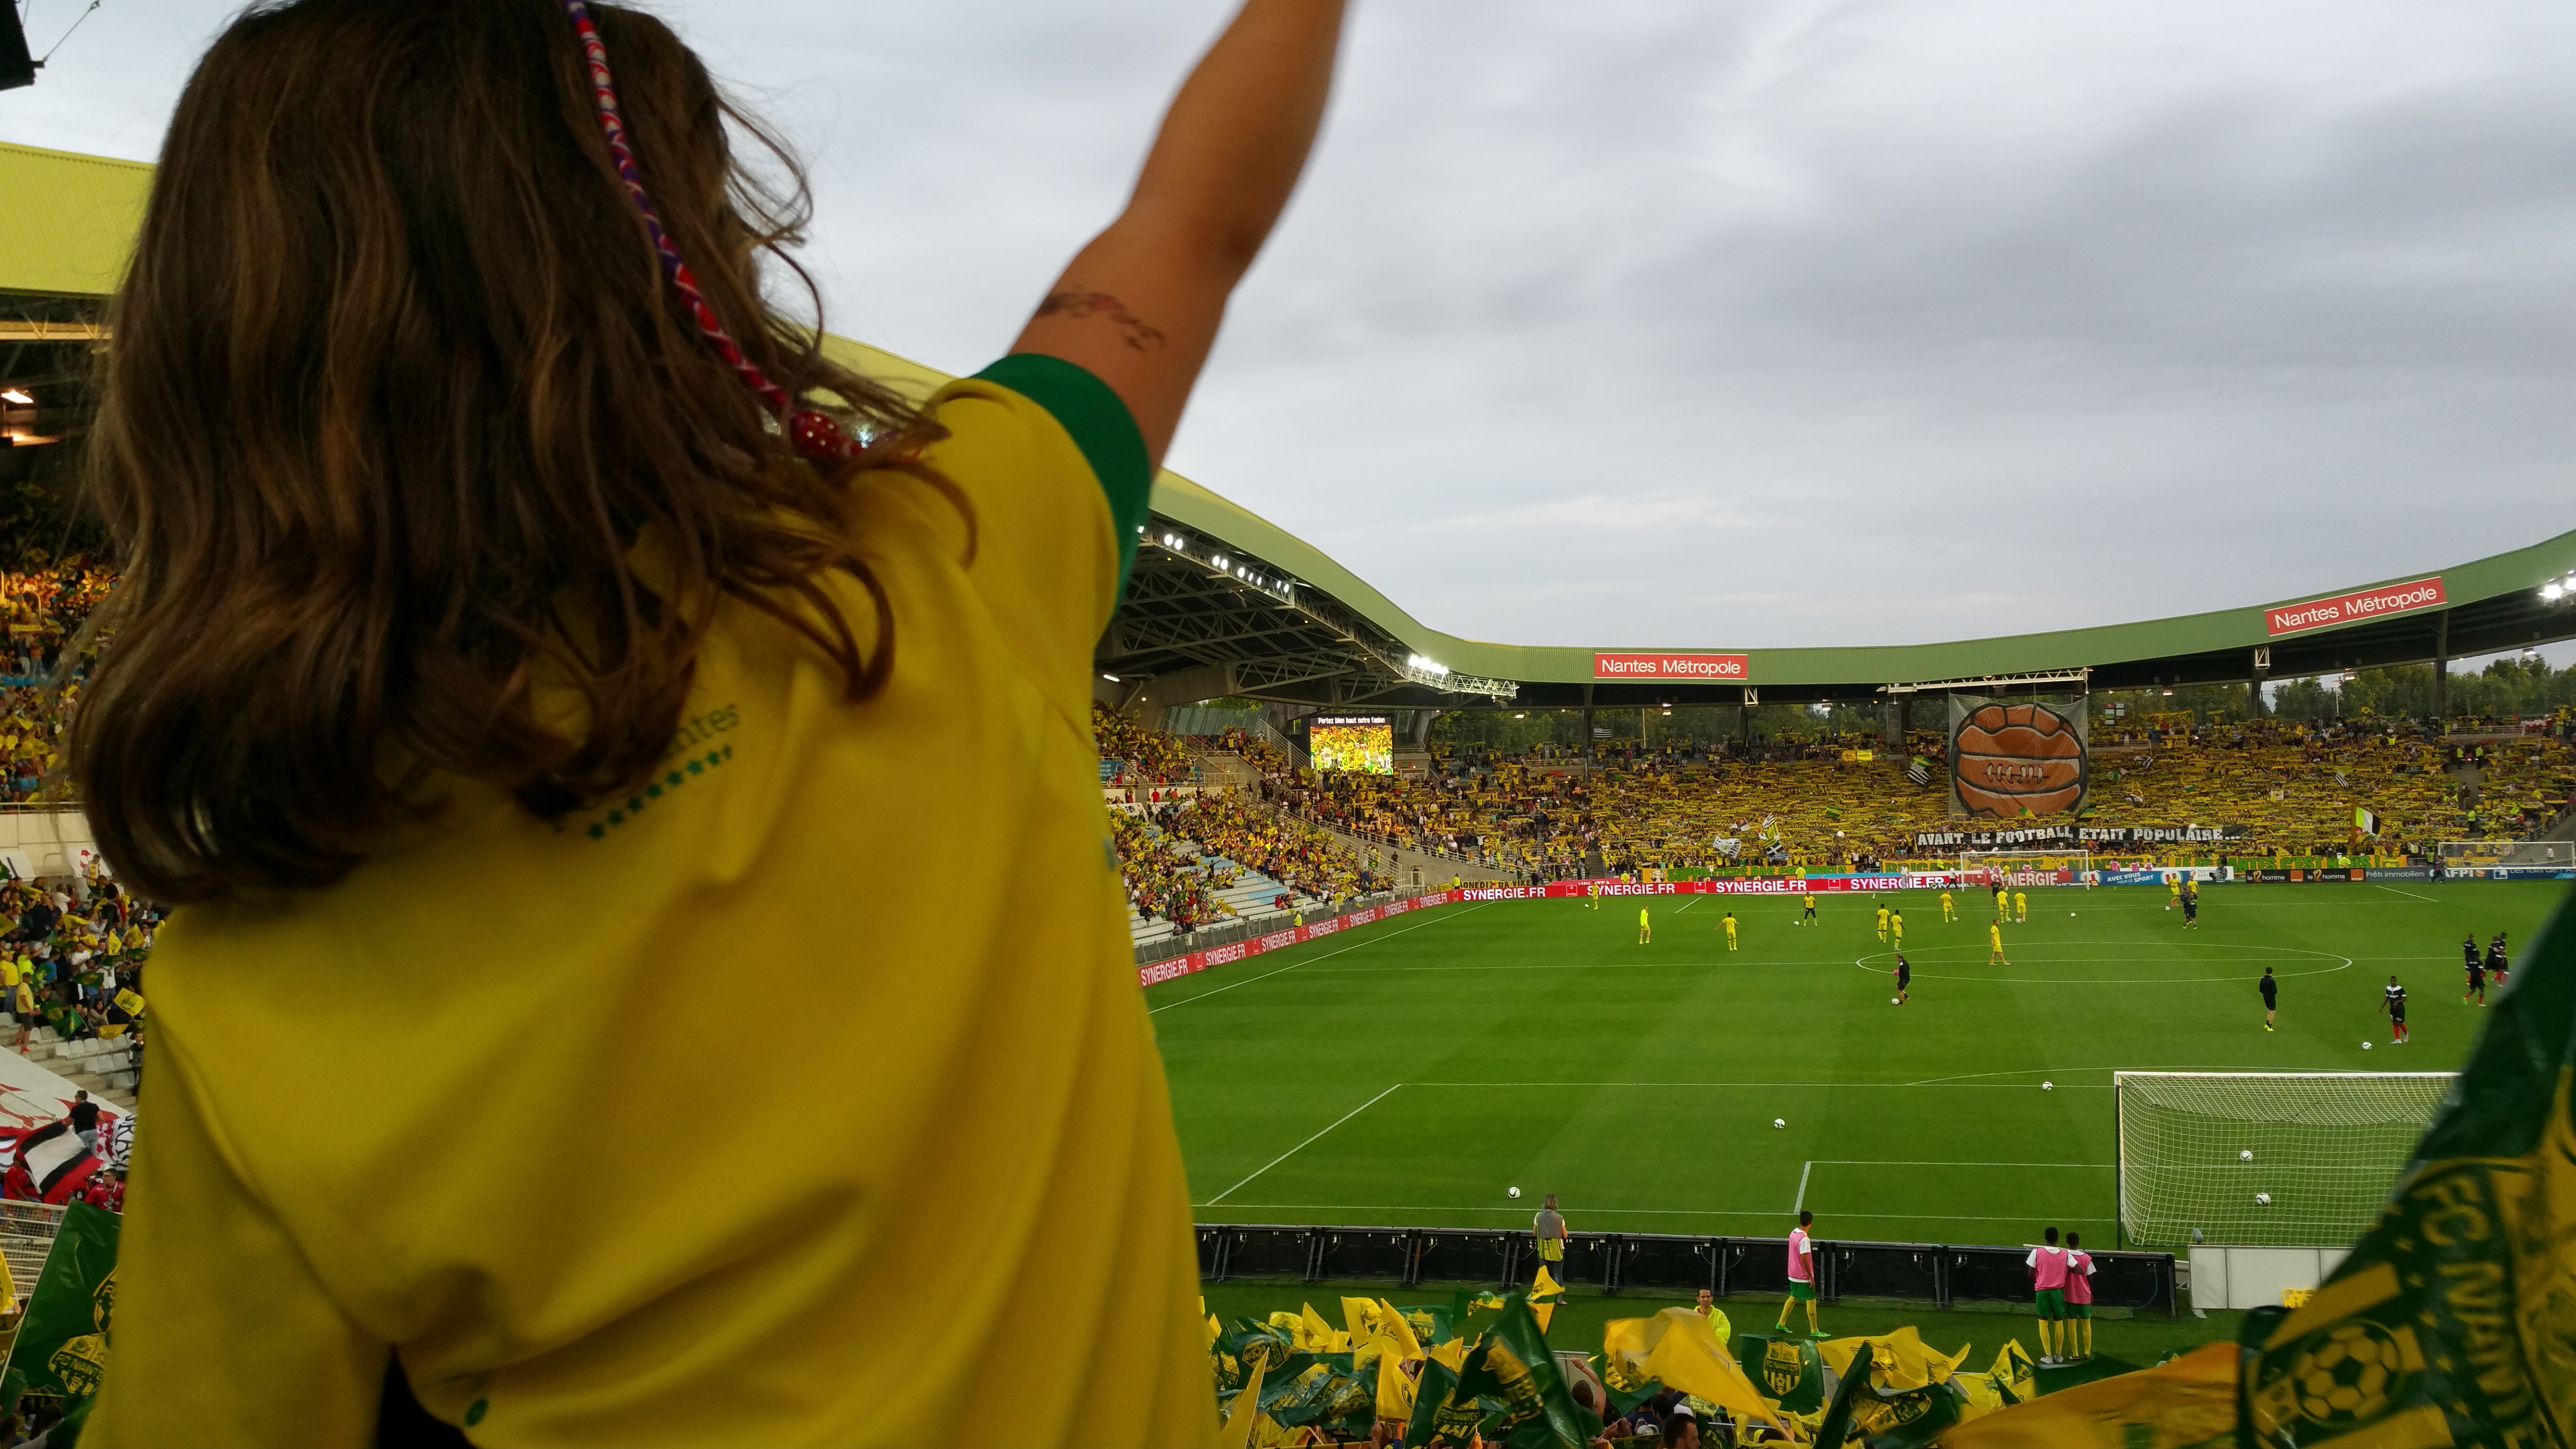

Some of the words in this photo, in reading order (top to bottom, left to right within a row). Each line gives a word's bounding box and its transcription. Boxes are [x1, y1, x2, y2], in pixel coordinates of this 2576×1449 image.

[2274, 606, 2339, 628] Nantes
[2345, 587, 2437, 615] Métropole
[1602, 659, 1657, 673] Nantes
[1663, 660, 1741, 676] Métropole
[671, 703, 739, 752] ntes
[1971, 833, 1991, 844] LE
[1996, 826, 2074, 844] FOOTBALL
[2078, 828, 2126, 840] ETAIT
[2280, 856, 2323, 869] C'EST
[2327, 856, 2371, 868] NUS
[1667, 867, 1747, 882] SUPPOTERS
[1778, 866, 1847, 875] CRINELS
[1464, 887, 1546, 901] SYNERGIE.FR
[1587, 883, 1675, 896] SYNERGIE.FR
[1716, 880, 1807, 893] SYNERGIE.FR
[1420, 892, 1448, 908] SYNERGIE.FR
[1384, 901, 1409, 917] SYNERGIE.FR
[1349, 909, 1376, 927] SYNERGIE.FR
[1309, 918, 1339, 939] SYNERGIE.FR
[1261, 930, 1296, 952] SYNERGIE.FR
[1205, 944, 1246, 966] SYNERGIE.FR
[1141, 958, 1189, 987] SYNERGIE.FR
